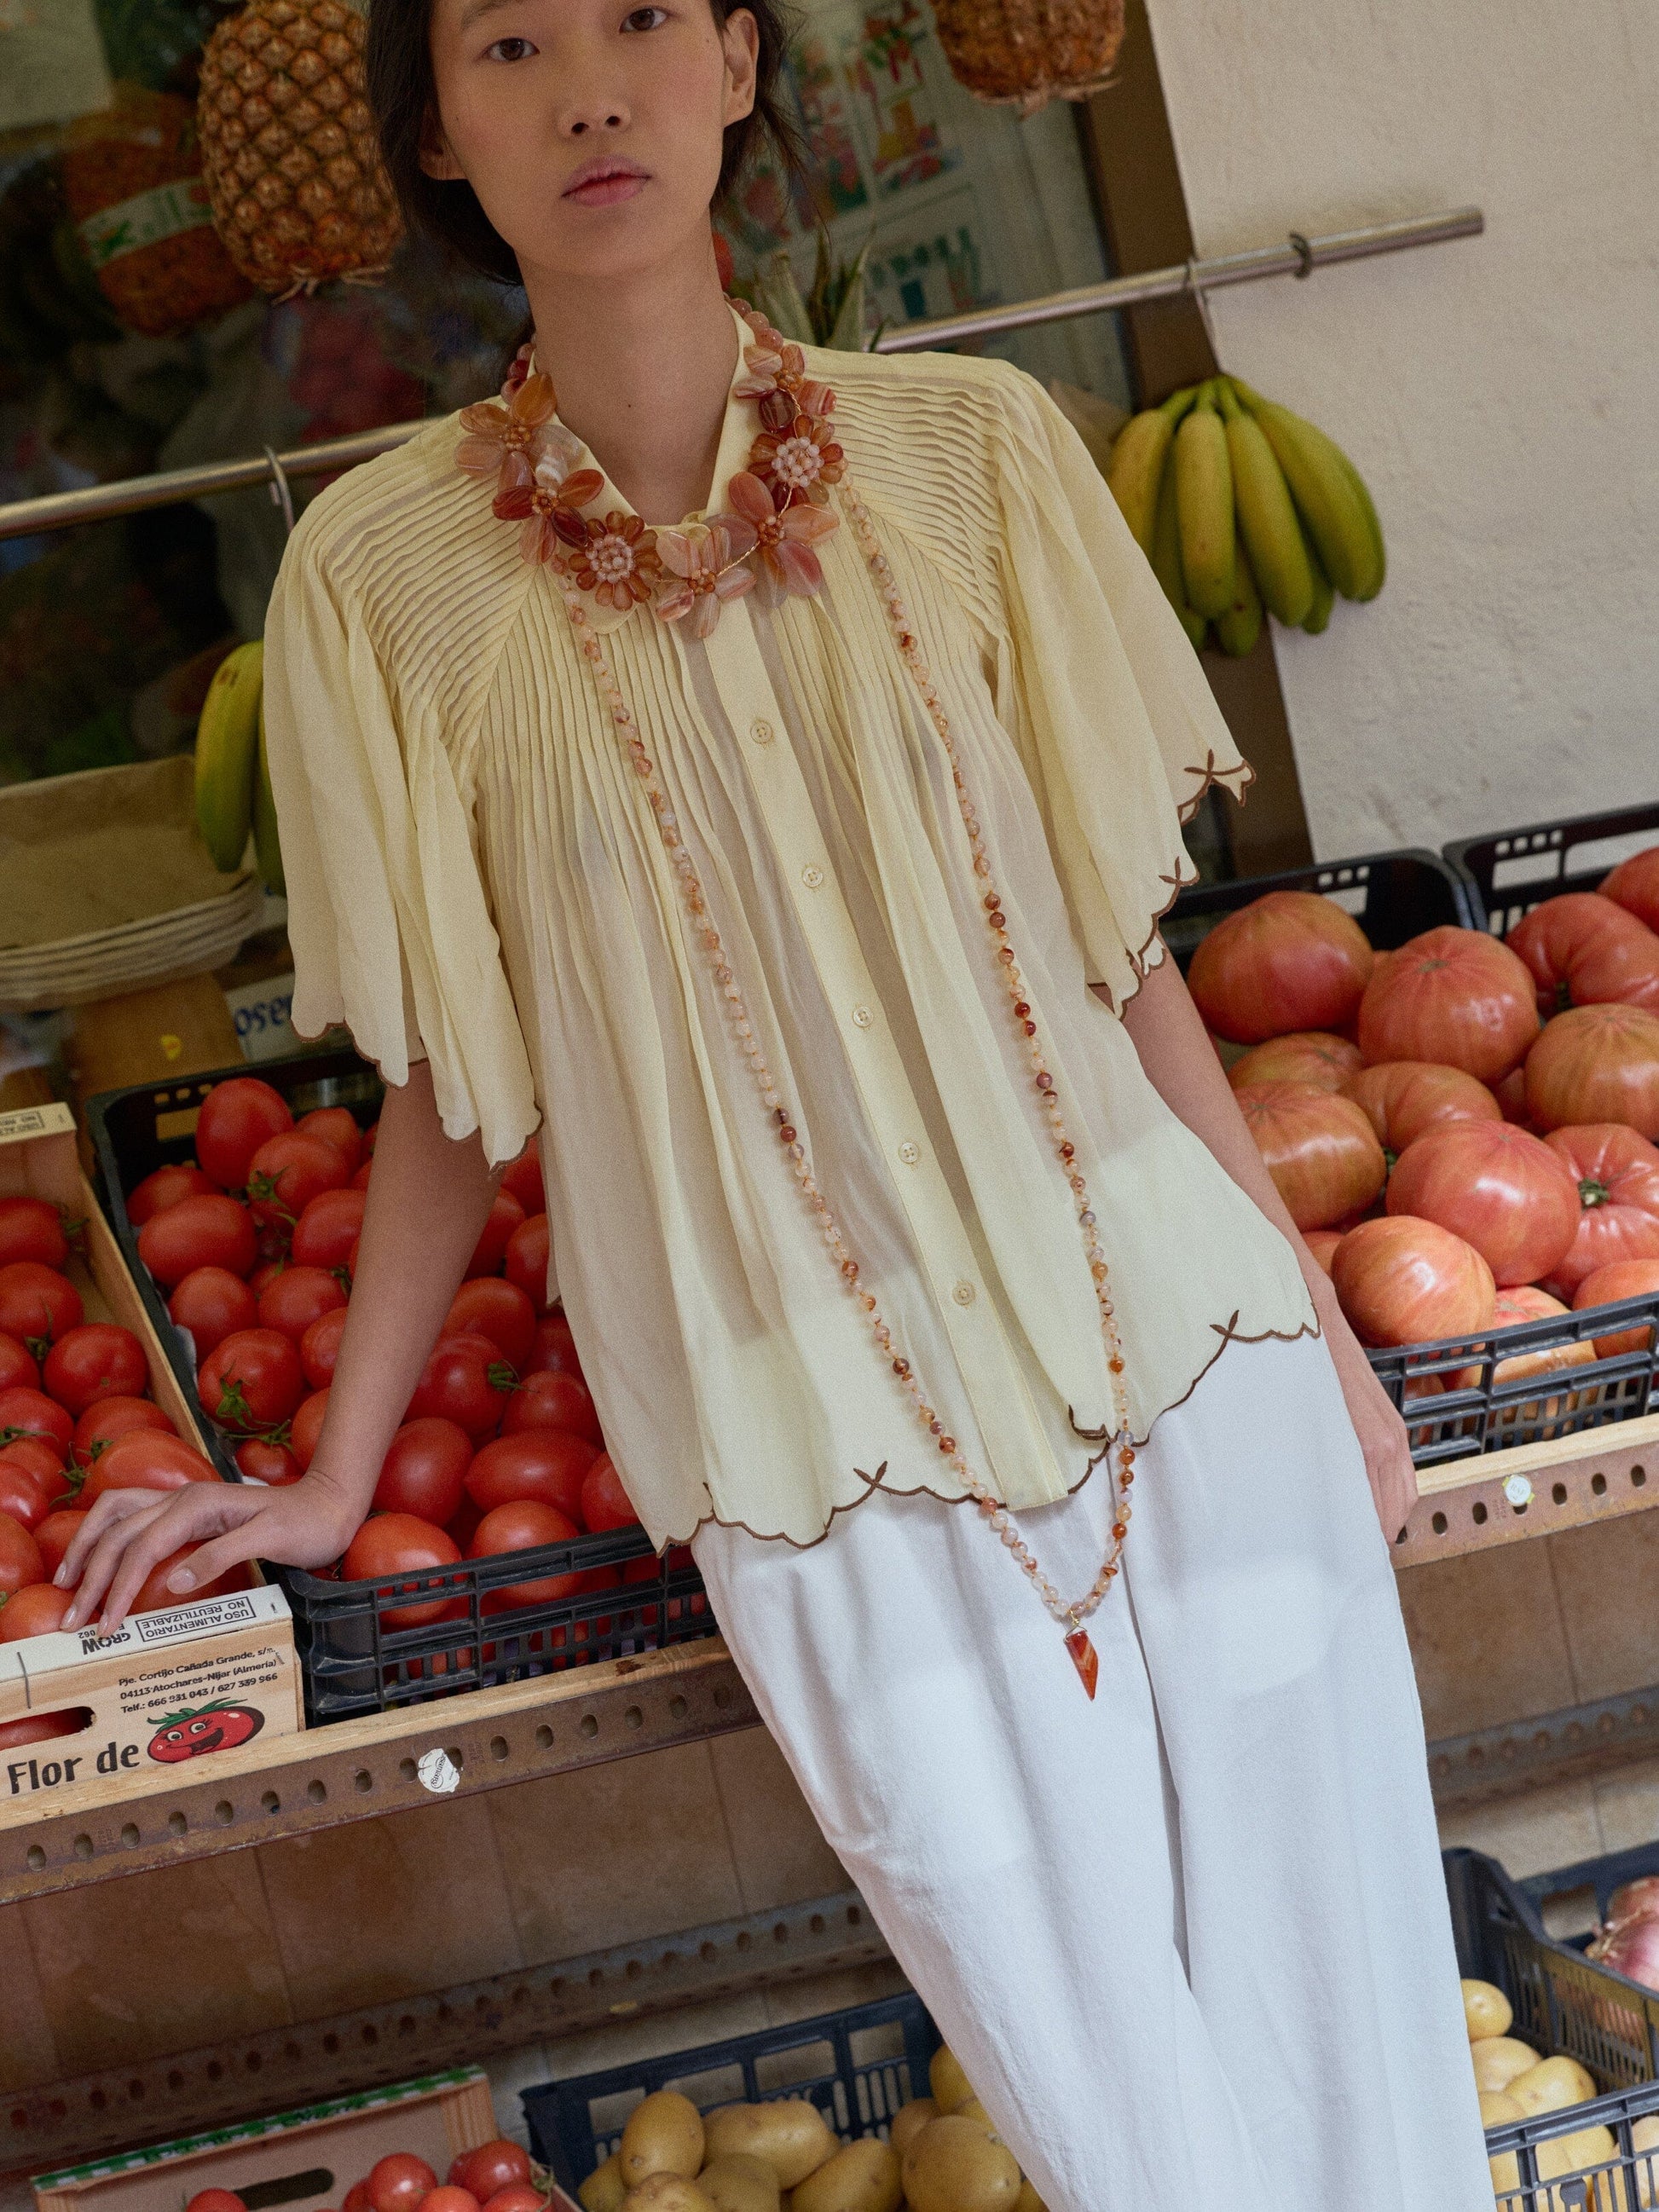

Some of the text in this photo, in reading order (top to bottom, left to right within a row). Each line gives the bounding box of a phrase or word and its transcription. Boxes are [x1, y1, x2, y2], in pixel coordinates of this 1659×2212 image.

[142, 1599, 246, 1629] NO REUTILIZABLE
[146, 1608, 250, 1637] USO ALIMENTARIO
[82, 1632, 131, 1655] GROW
[118, 1678, 136, 1687] Pje.
[139, 1668, 175, 1682] Cortijo
[216, 1650, 256, 1665] Grande,
[121, 1701, 146, 1714] Telf.:
[147, 1697, 167, 1708] 666
[188, 1688, 209, 1699] 043
[217, 1681, 236, 1694] 627
[258, 1672, 278, 1684] 966
[7, 1741, 141, 1794] Flor de
